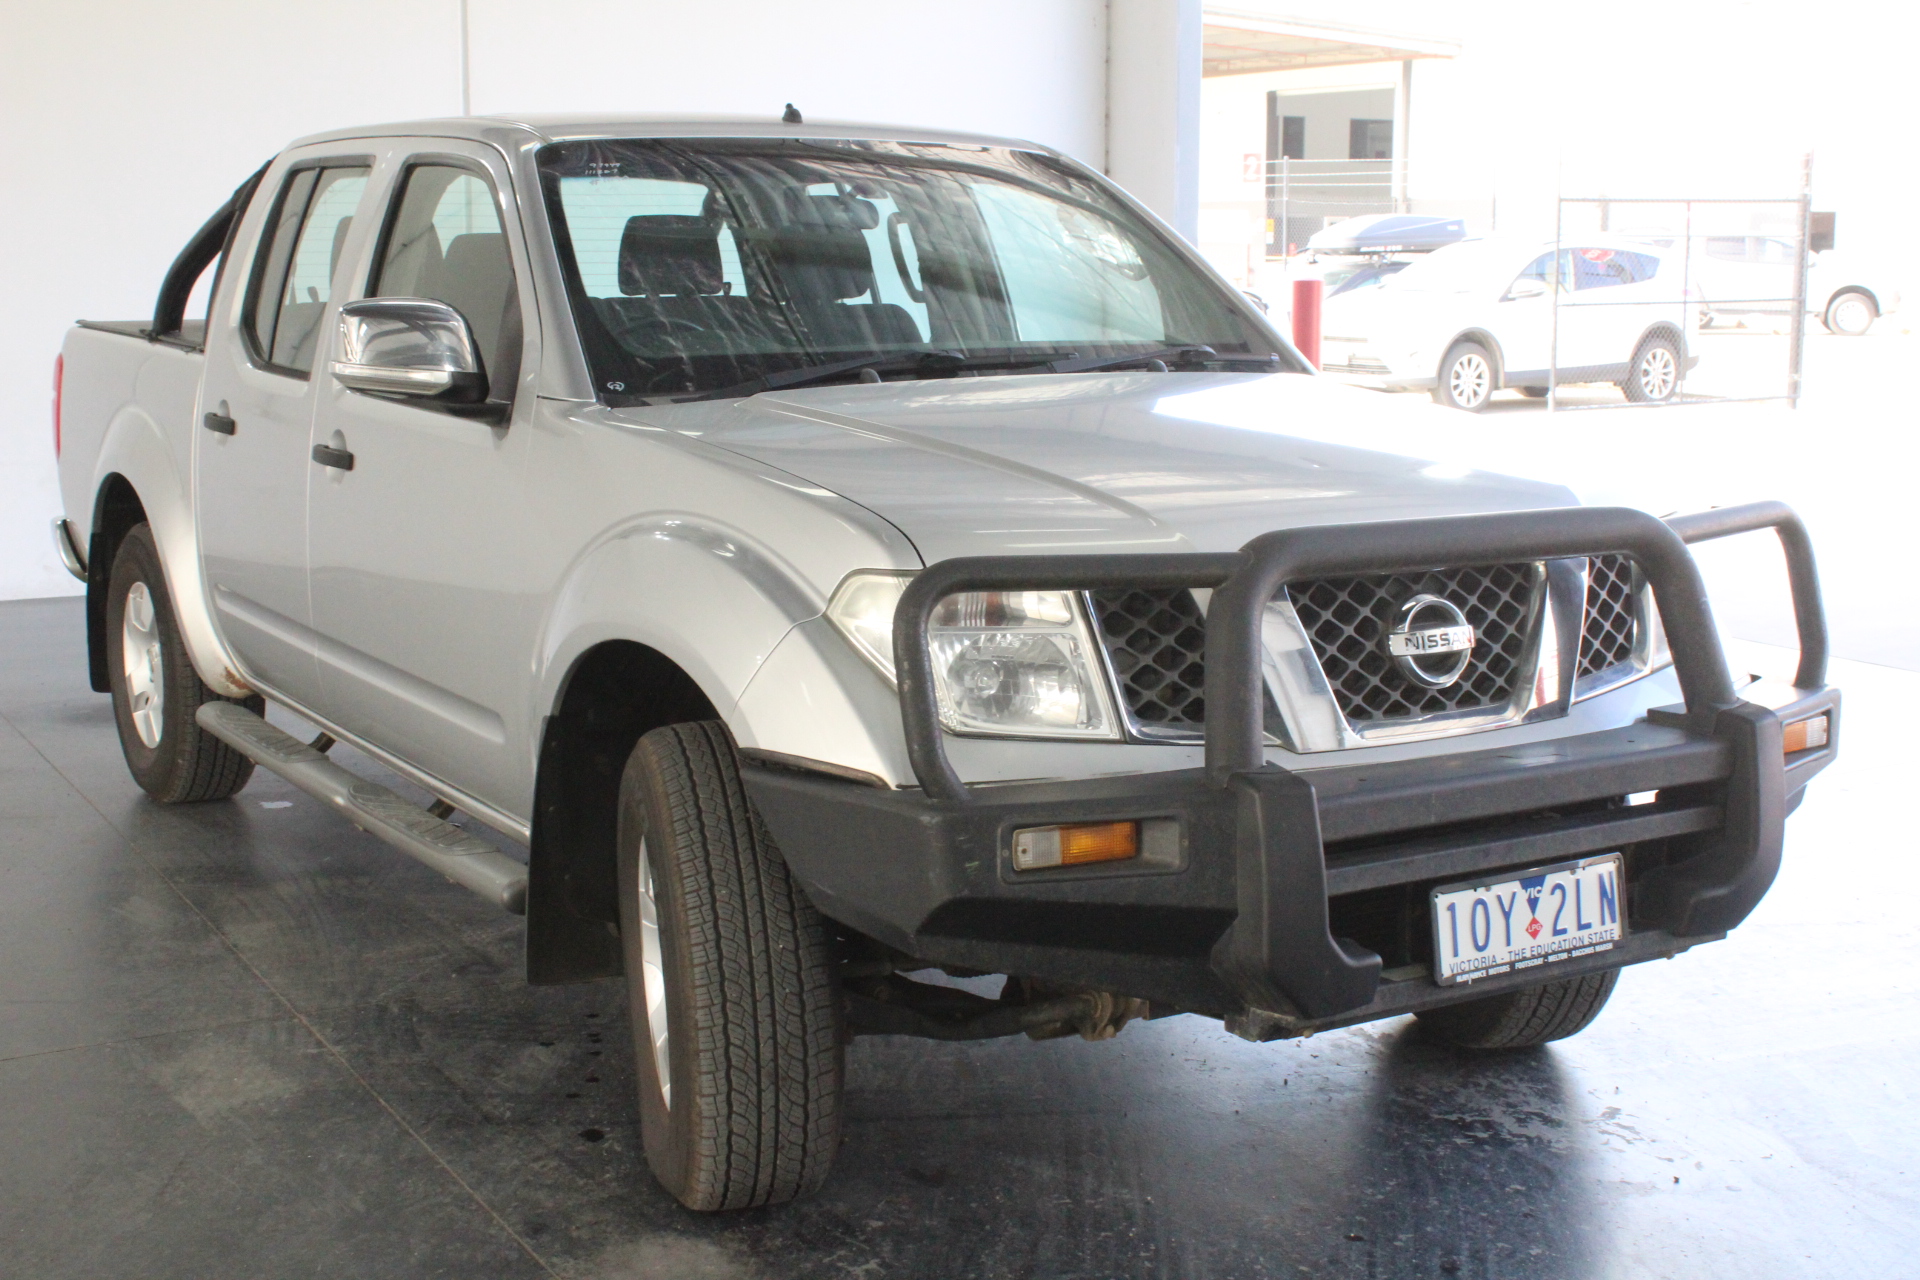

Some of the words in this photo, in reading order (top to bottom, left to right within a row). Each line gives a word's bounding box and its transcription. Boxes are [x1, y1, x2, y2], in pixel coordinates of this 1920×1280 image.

[1404, 632, 1473, 651] NISSAN
[1524, 886, 1542, 898] VIC
[1550, 871, 1617, 937] 2LN
[1528, 923, 1542, 933] LPG
[1449, 955, 1497, 973] VICTORIA
[1508, 947, 1527, 961] THE
[1530, 936, 1584, 956] EDUCATION
[1587, 928, 1615, 944] STATE
